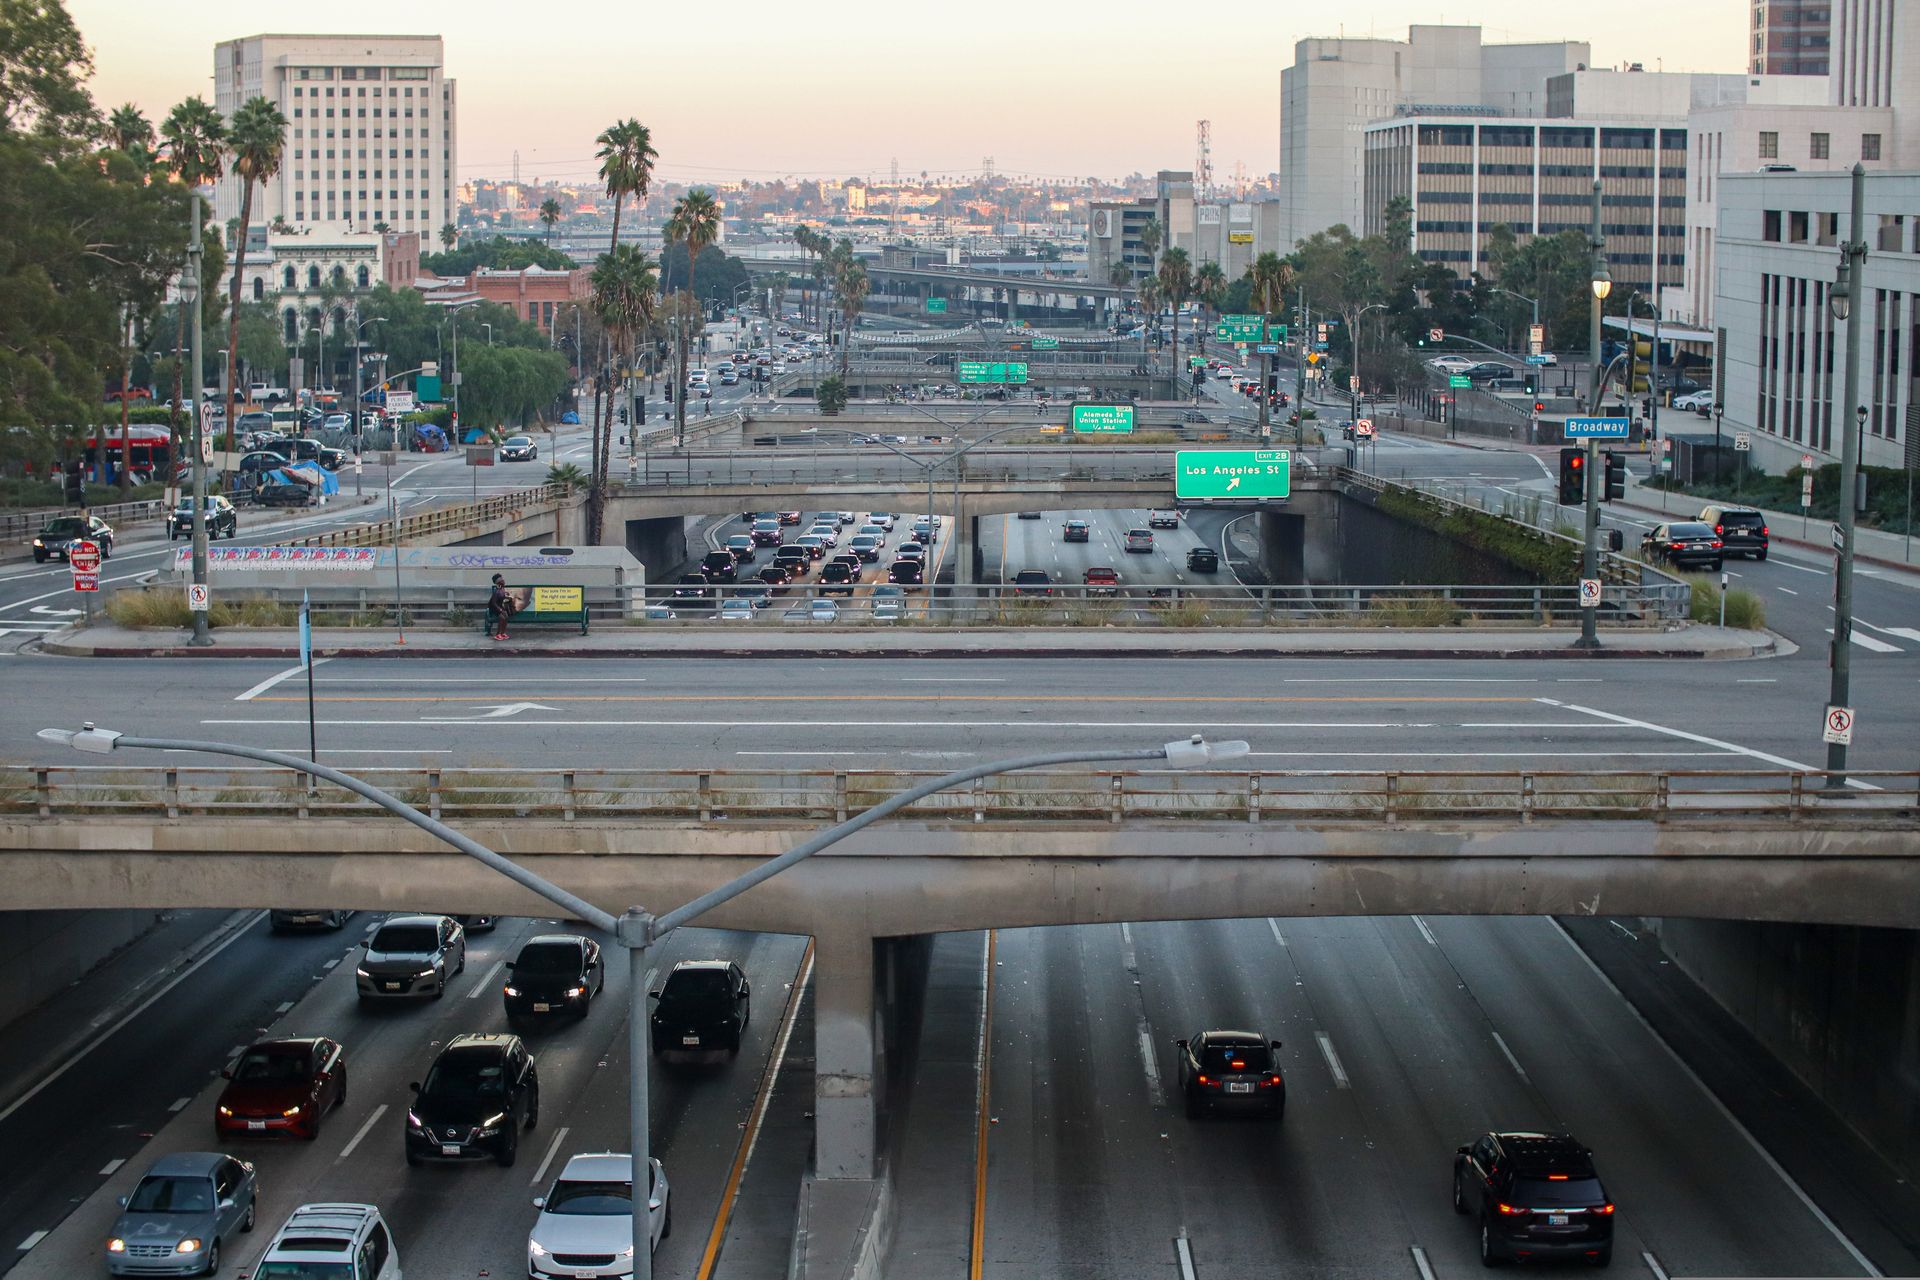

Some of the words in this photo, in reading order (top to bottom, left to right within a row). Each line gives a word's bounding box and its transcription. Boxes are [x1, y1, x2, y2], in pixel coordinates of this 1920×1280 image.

[1570, 422, 1624, 434] Broadway
[1186, 466, 1206, 475] Los
[1213, 466, 1260, 476] Angeles
[1266, 466, 1279, 475] St
